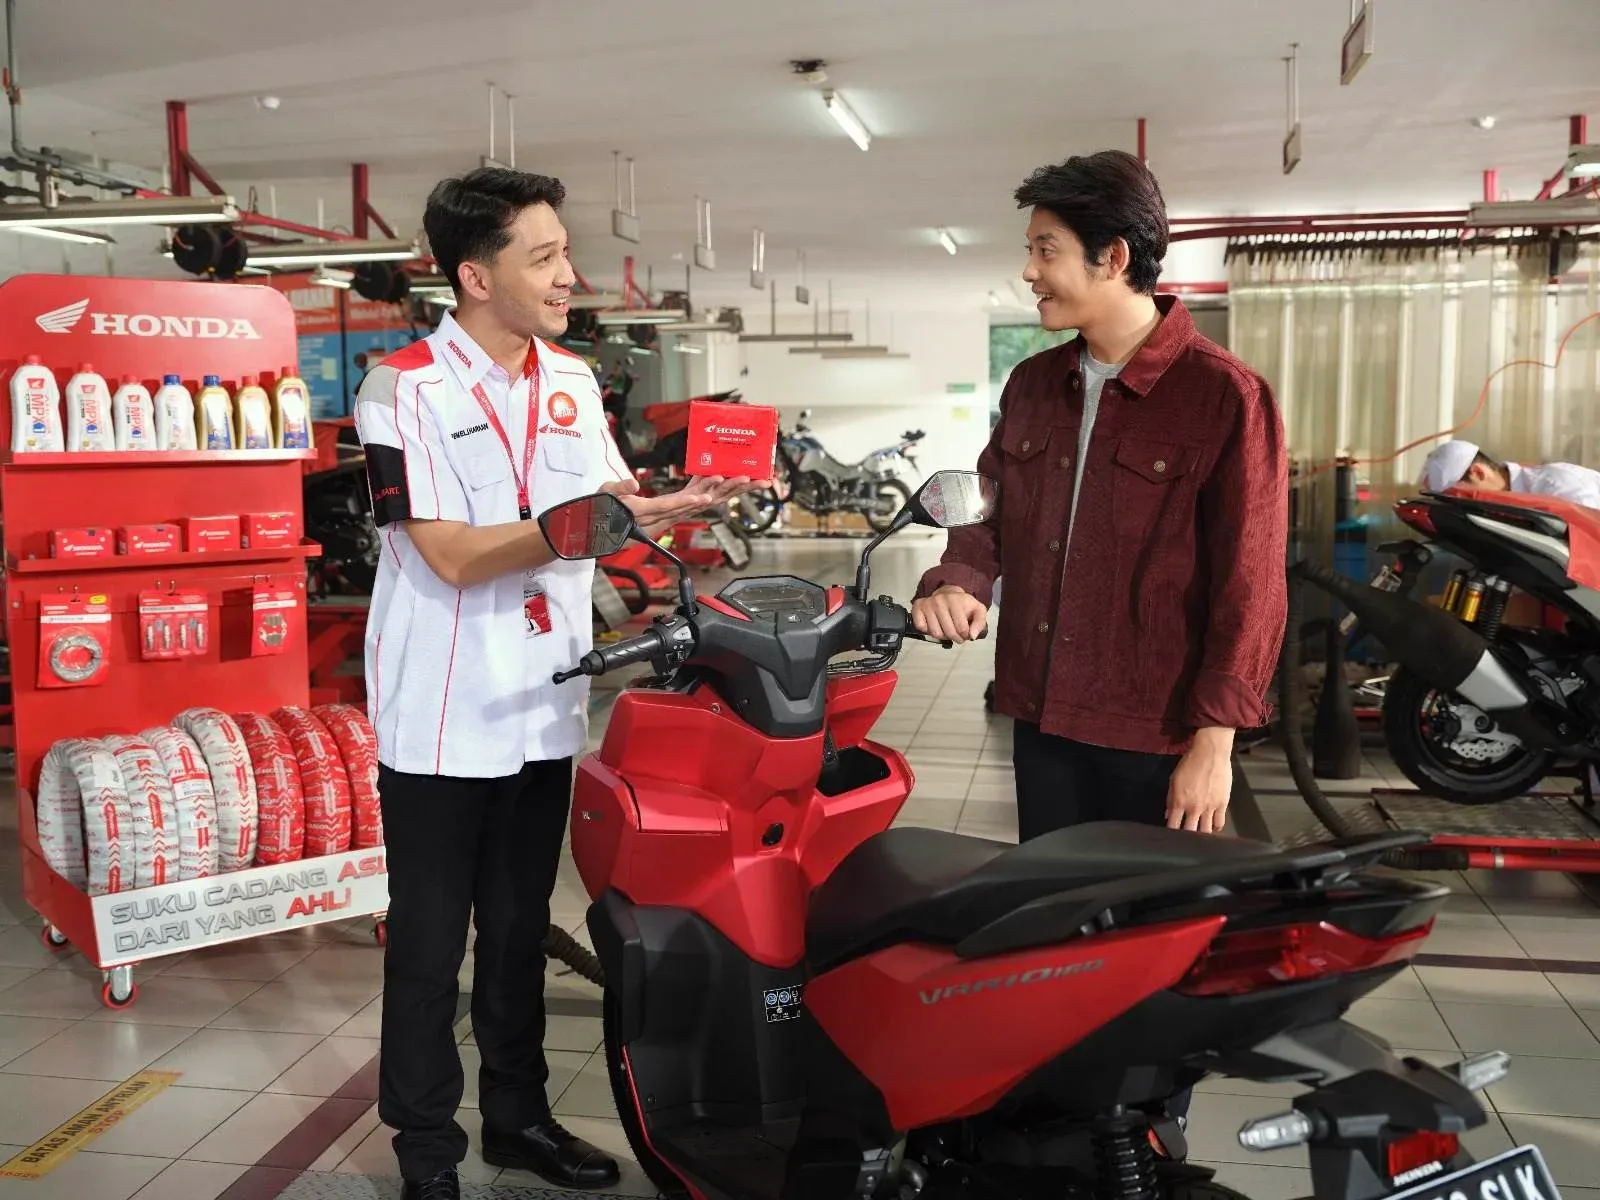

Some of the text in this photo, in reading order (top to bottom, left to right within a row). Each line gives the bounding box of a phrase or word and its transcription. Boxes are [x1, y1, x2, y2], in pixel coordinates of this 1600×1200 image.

[90, 313, 262, 340] HONDA
[447, 339, 473, 369] HONDA
[716, 427, 757, 436] HONDA
[111, 891, 198, 925] SUKU
[203, 868, 328, 907] CADANG
[114, 922, 190, 953] DARI
[195, 904, 276, 936] YANG
[22, 1080, 150, 1164] BATAS AMAN ANTRIAN
